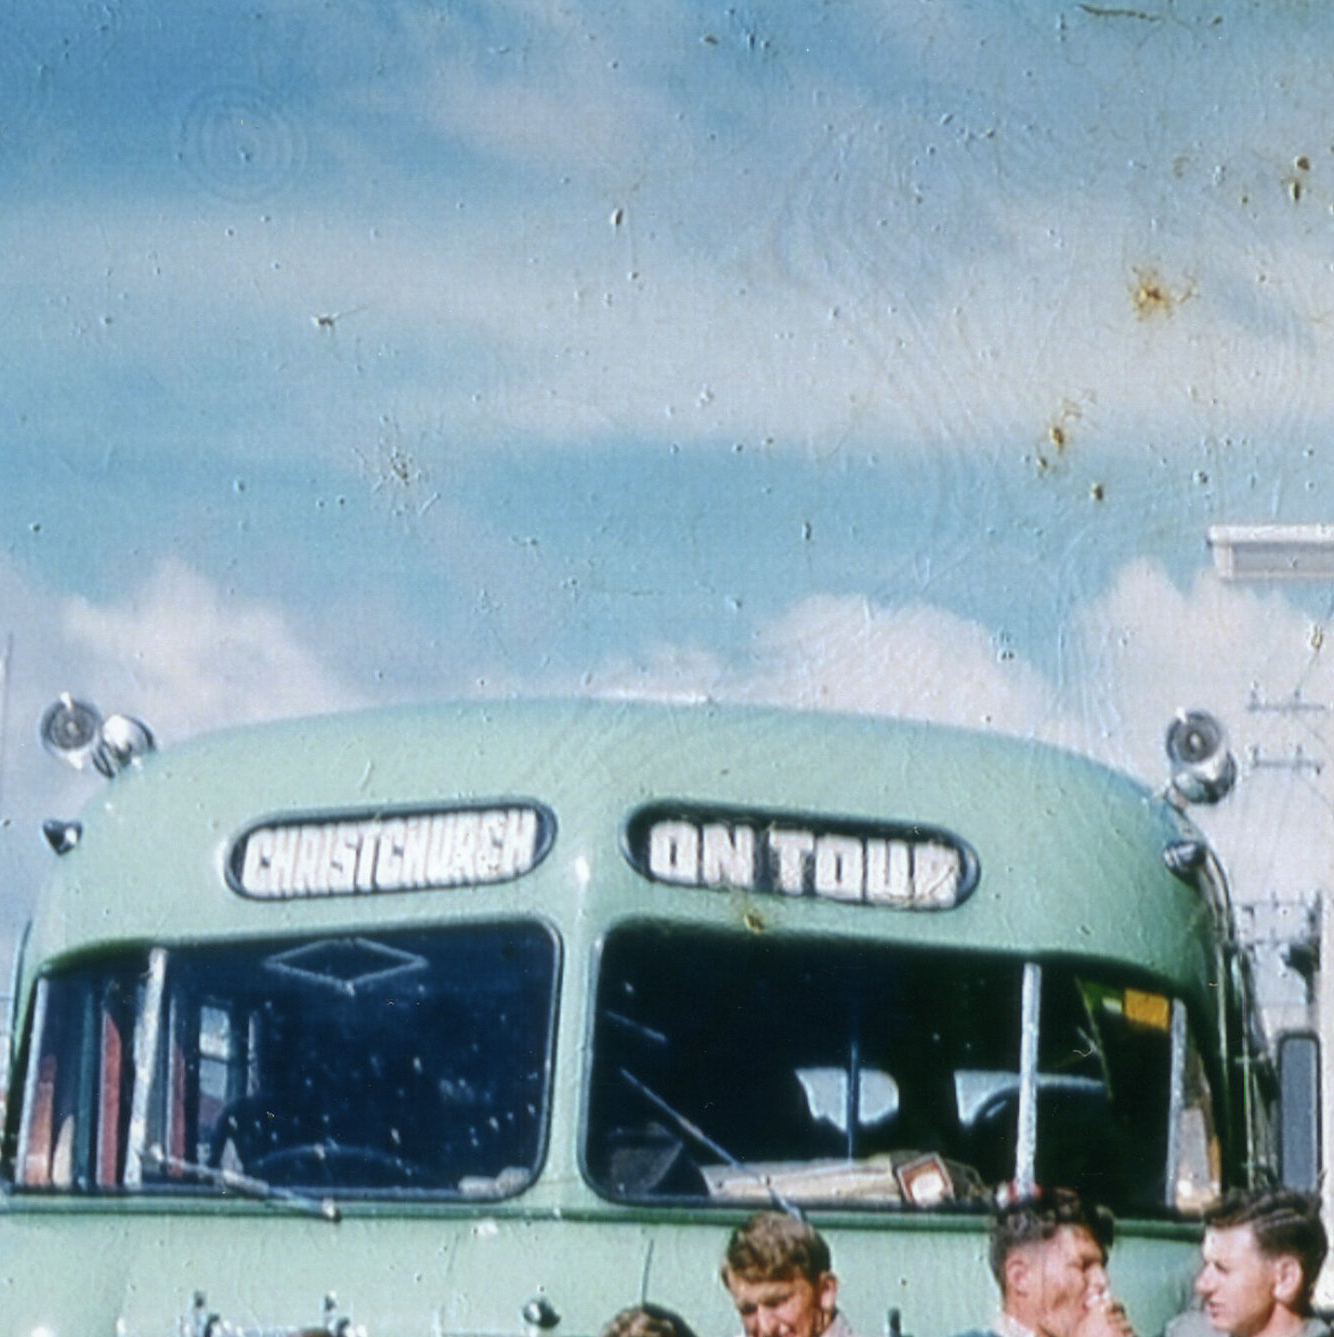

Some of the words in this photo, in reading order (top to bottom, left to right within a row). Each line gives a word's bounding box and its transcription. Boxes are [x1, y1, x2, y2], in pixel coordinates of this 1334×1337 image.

[243, 808, 537, 896] CHRISTCHURCH
[650, 820, 754, 887] ON
[768, 829, 960, 907] TOUR
